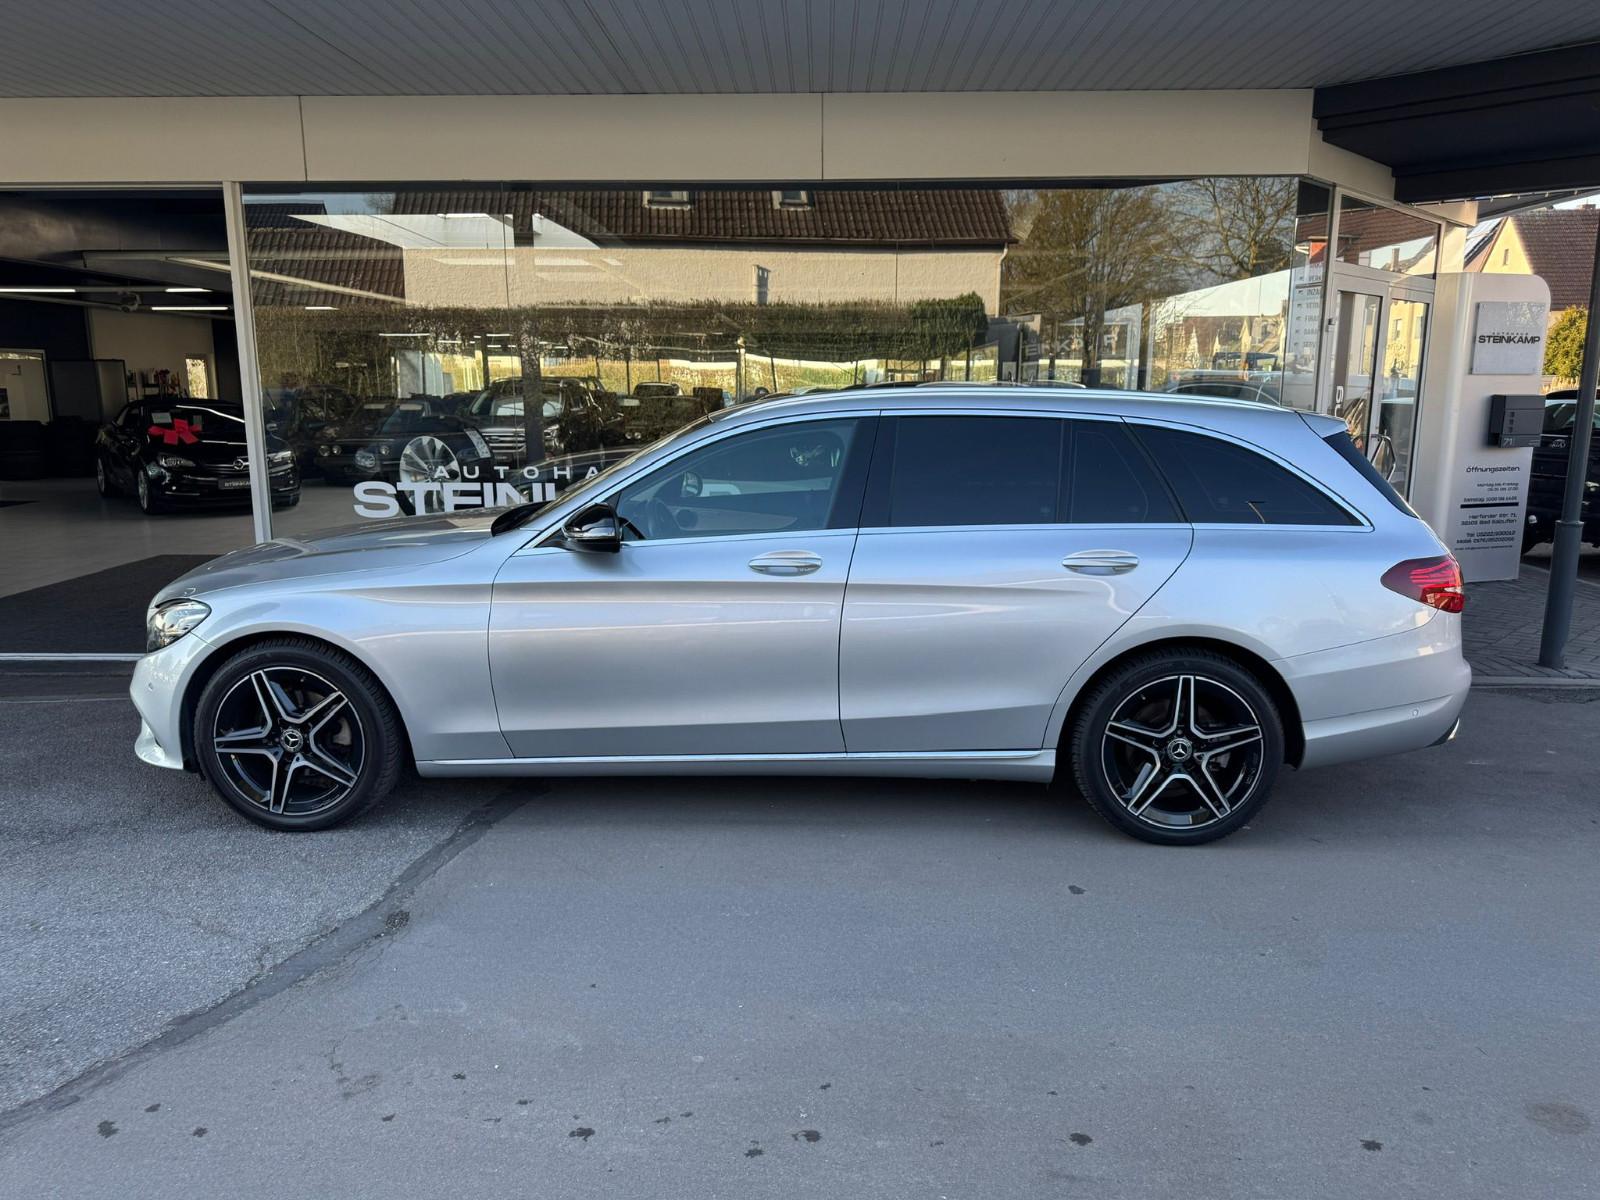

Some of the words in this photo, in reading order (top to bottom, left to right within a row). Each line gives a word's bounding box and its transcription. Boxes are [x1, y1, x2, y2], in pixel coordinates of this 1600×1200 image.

[1478, 335, 1541, 344] STEINKAMP
[1503, 437, 1513, 446] 71
[1465, 465, 1520, 474] Öffnungszeiten
[353, 481, 556, 518] STEIN
